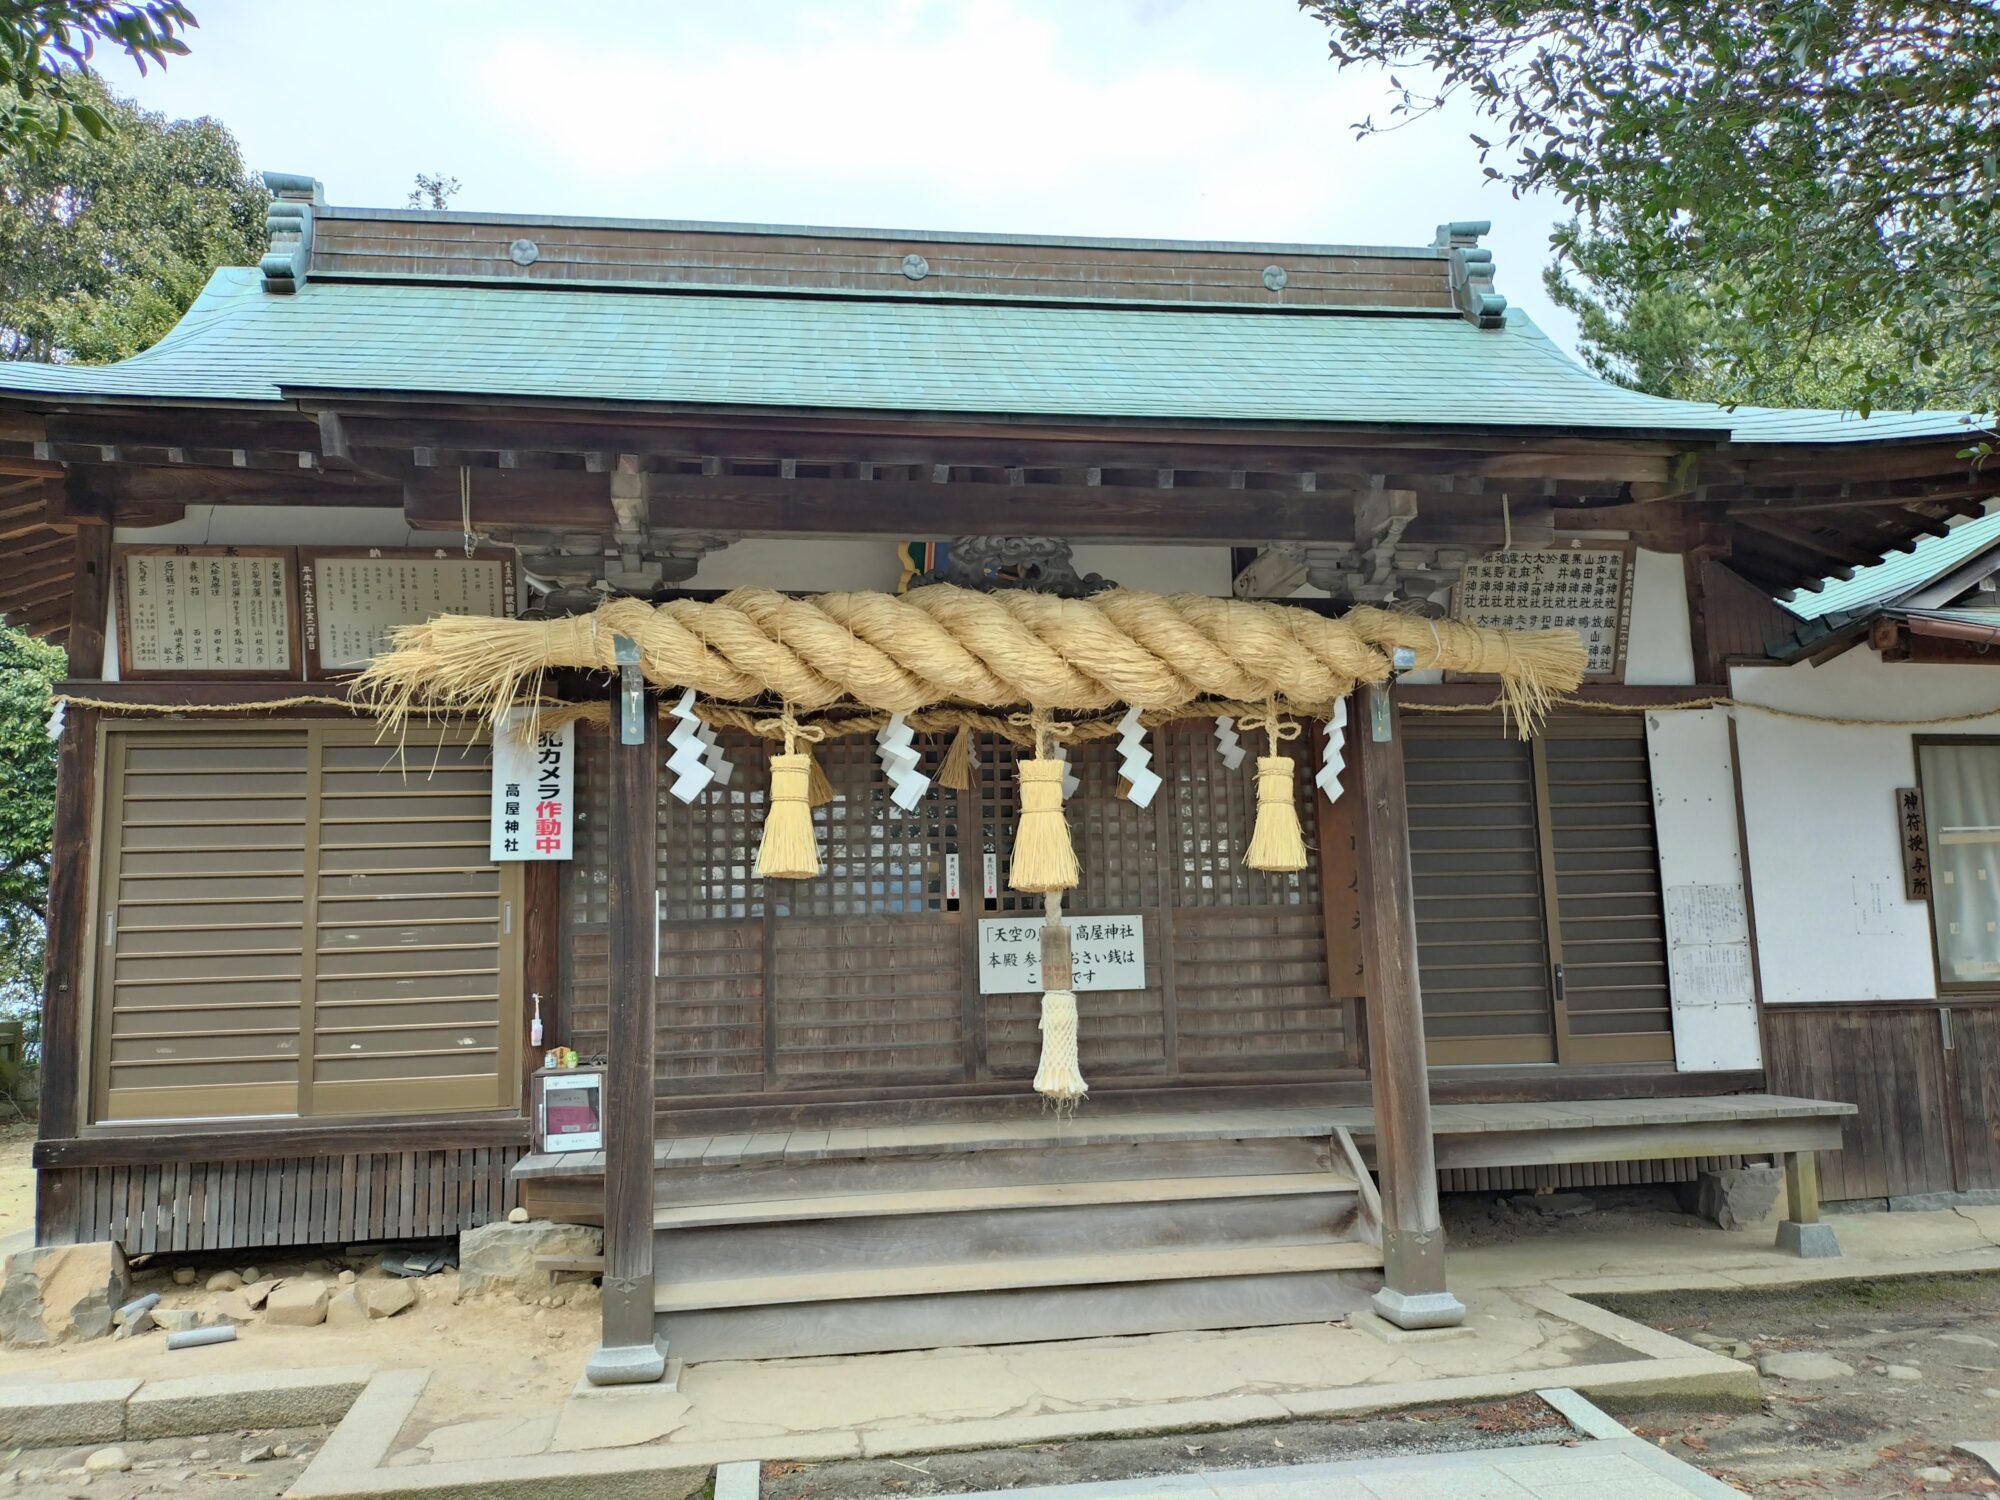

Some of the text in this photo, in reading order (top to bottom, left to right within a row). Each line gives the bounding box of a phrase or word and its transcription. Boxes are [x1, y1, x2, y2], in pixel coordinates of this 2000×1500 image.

[1530, 552, 1545, 609] 大水上神社
[1579, 553, 1594, 609] 山田神社
[1604, 554, 1621, 609] 高屋神社
[504, 783, 520, 852] 高屋神社
[535, 730, 564, 855] 犯カメラ作動中
[1903, 791, 1928, 895] 神符授与所
[1076, 923, 1135, 941] 高屋神社
[1027, 969, 1096, 984] こです
